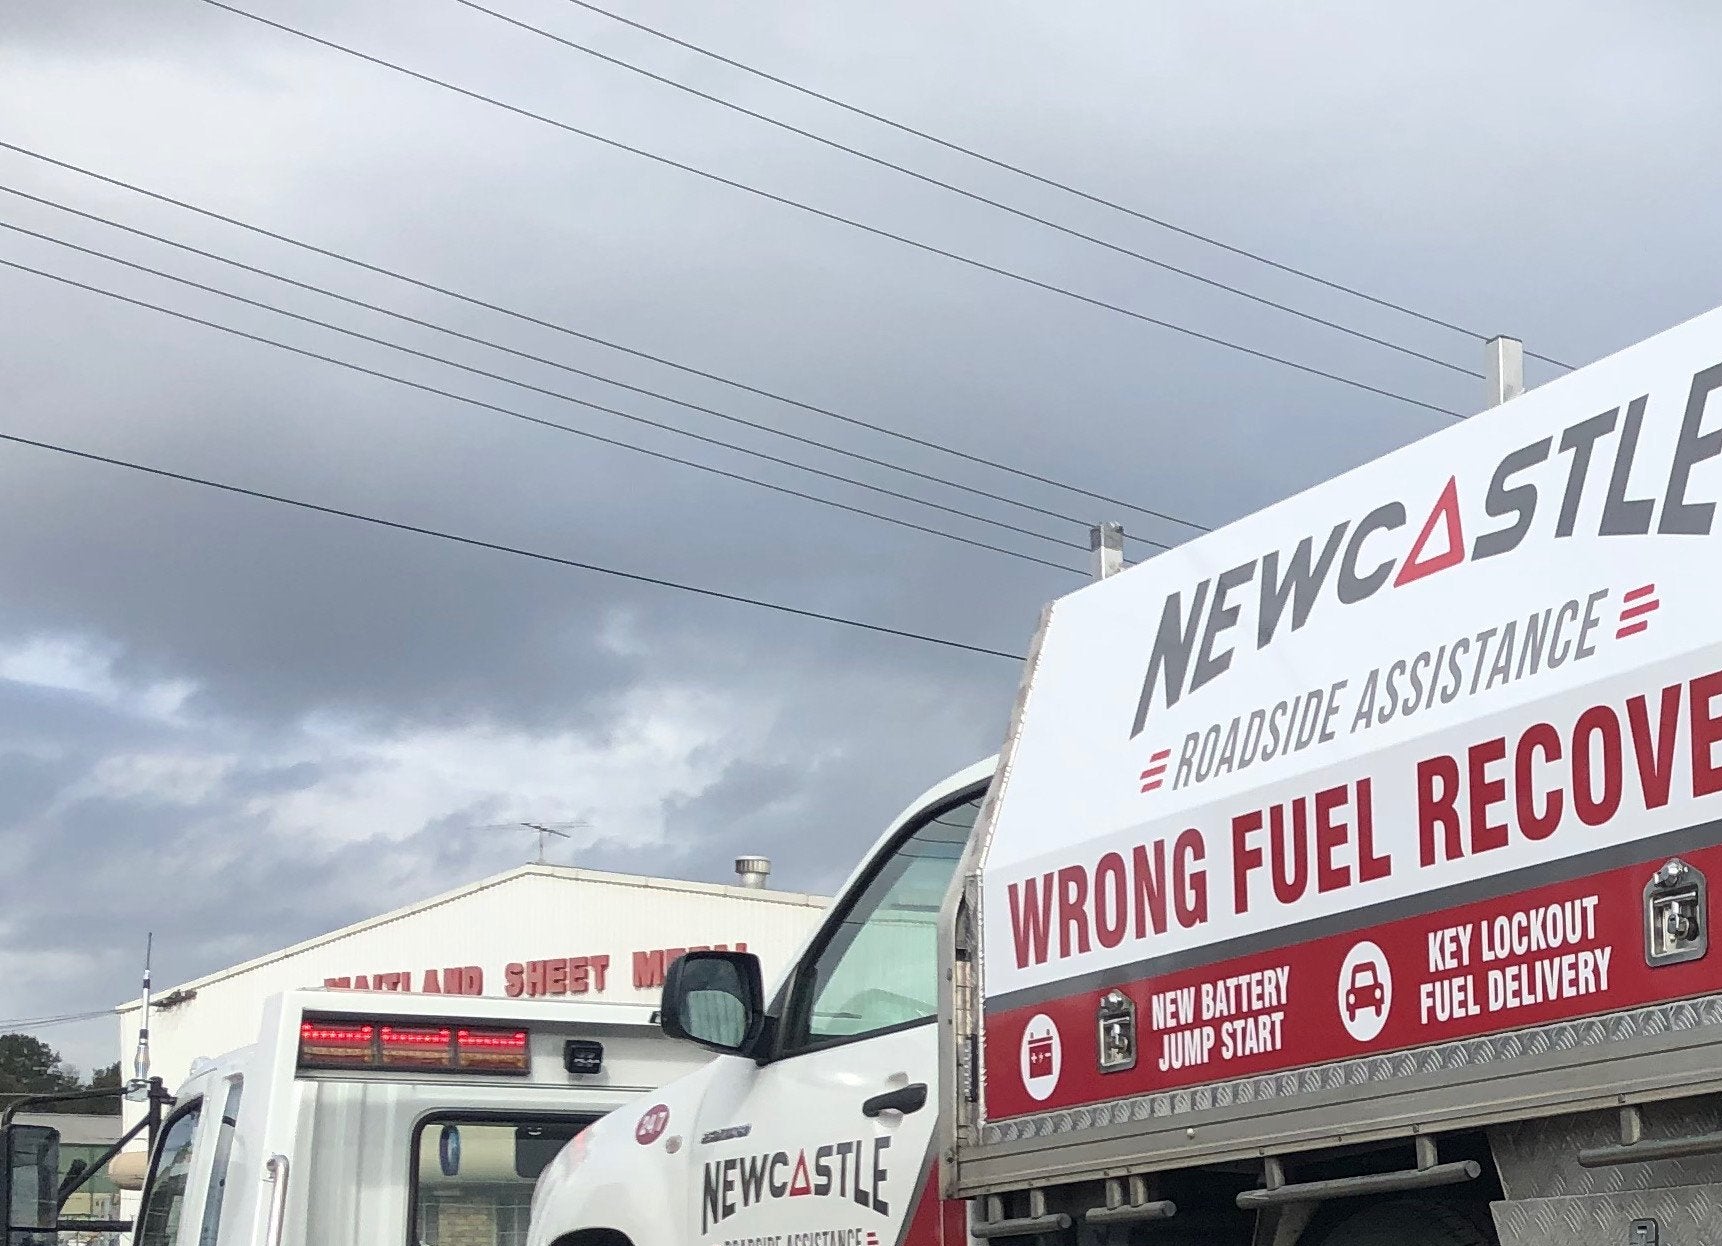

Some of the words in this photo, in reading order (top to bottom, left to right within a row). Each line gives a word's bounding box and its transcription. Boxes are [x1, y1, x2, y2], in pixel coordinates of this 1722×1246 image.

[1172, 679, 1349, 791] ROADSIDE
[1350, 588, 1609, 735] ASSISTANCE
[1008, 831, 1208, 970] WRONG
[1231, 778, 1393, 915] FUEL
[1427, 922, 1473, 973] KEY
[1481, 895, 1599, 961] LOCKOUT
[504, 954, 610, 998] SHEET
[1151, 985, 1196, 1031] NEW
[1201, 965, 1290, 1017] BATTERY
[1419, 976, 1481, 1025] FUEL
[1487, 946, 1613, 1012] DELIVERY
[1158, 1026, 1215, 1072] JUMP
[1221, 1012, 1285, 1061] START
[700, 1135, 892, 1236] NEWCASTLE
